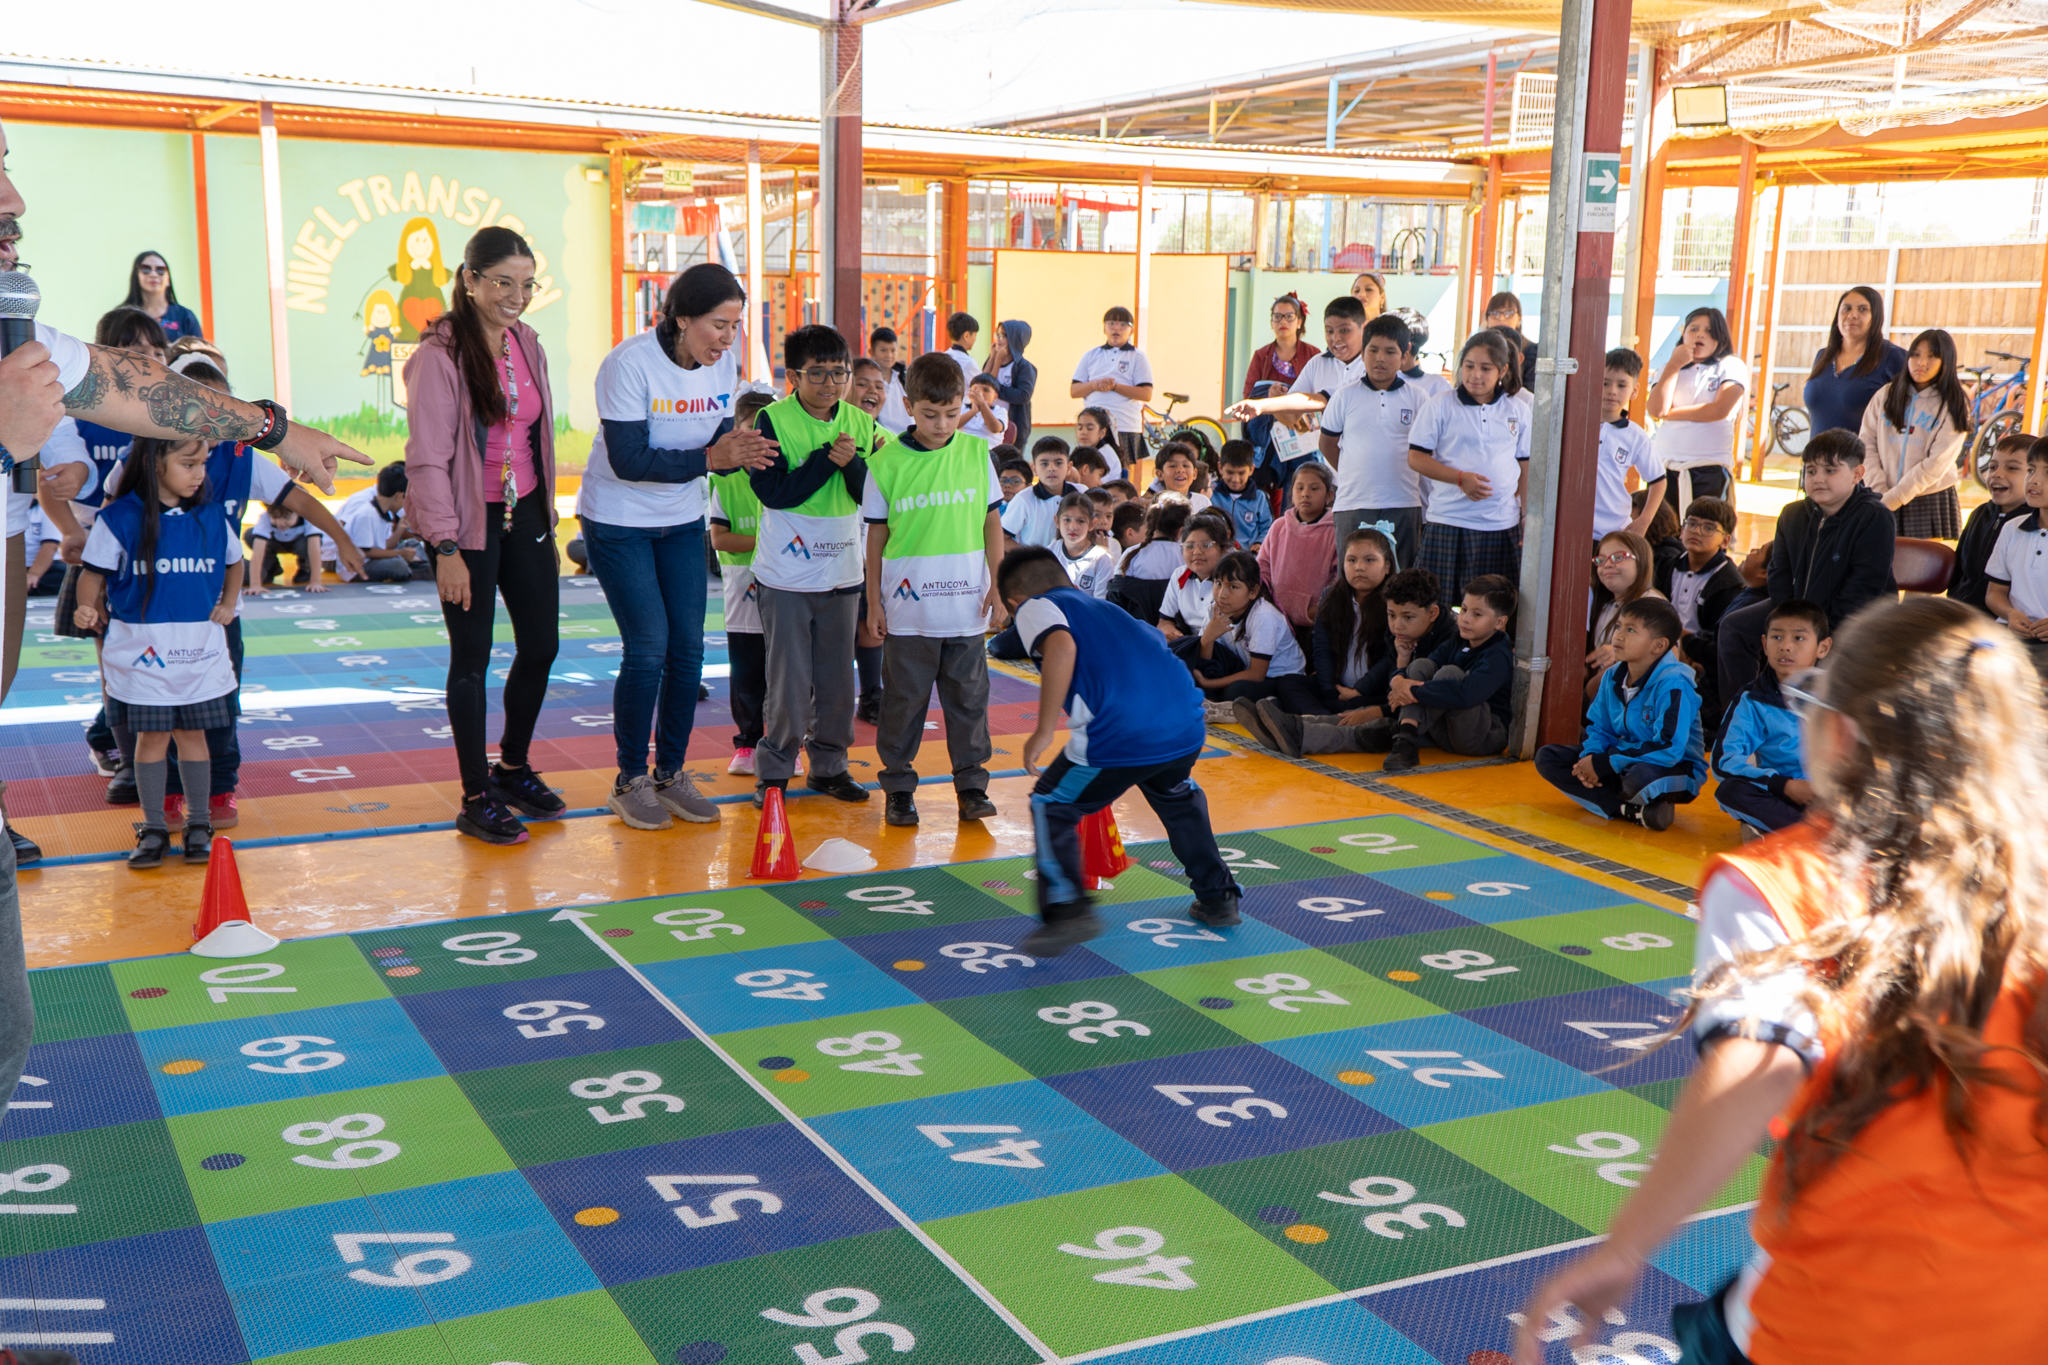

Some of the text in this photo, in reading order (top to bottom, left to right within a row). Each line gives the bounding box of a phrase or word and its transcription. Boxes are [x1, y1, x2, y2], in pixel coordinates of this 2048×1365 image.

[286, 171, 564, 315] NIVEL TRANSIN
[922, 580, 969, 590] ANTUCOYA
[262, 735, 323, 751] 18
[290, 766, 355, 783] 12
[324, 802, 389, 813] 6
[763, 833, 785, 863] 7
[1338, 833, 1418, 854] 10
[846, 886, 934, 915] 40
[1466, 882, 1530, 896] 9
[653, 908, 745, 942] 50
[1298, 897, 1384, 922] 19
[442, 931, 537, 966] 60
[1127, 918, 1226, 948] 29
[1601, 932, 1673, 951] 8
[939, 942, 1035, 973] 39
[1420, 950, 1519, 981] 18
[199, 963, 297, 1003] 70
[735, 969, 828, 1001] 49
[1235, 973, 1350, 1012] 28
[503, 1000, 605, 1038] 59
[1037, 1001, 1151, 1043] 38
[240, 1035, 346, 1074] 69
[816, 1031, 923, 1076] 48
[1365, 1050, 1504, 1088] 27
[570, 1070, 685, 1124] 58
[1153, 1085, 1287, 1127] 37
[282, 1113, 401, 1169] 68
[917, 1124, 1045, 1168] 47
[646, 1175, 782, 1228] 57
[1317, 1176, 1466, 1239] 36
[333, 1232, 472, 1287] 67
[1057, 1226, 1198, 1290] 46
[760, 1287, 916, 1365] 56
